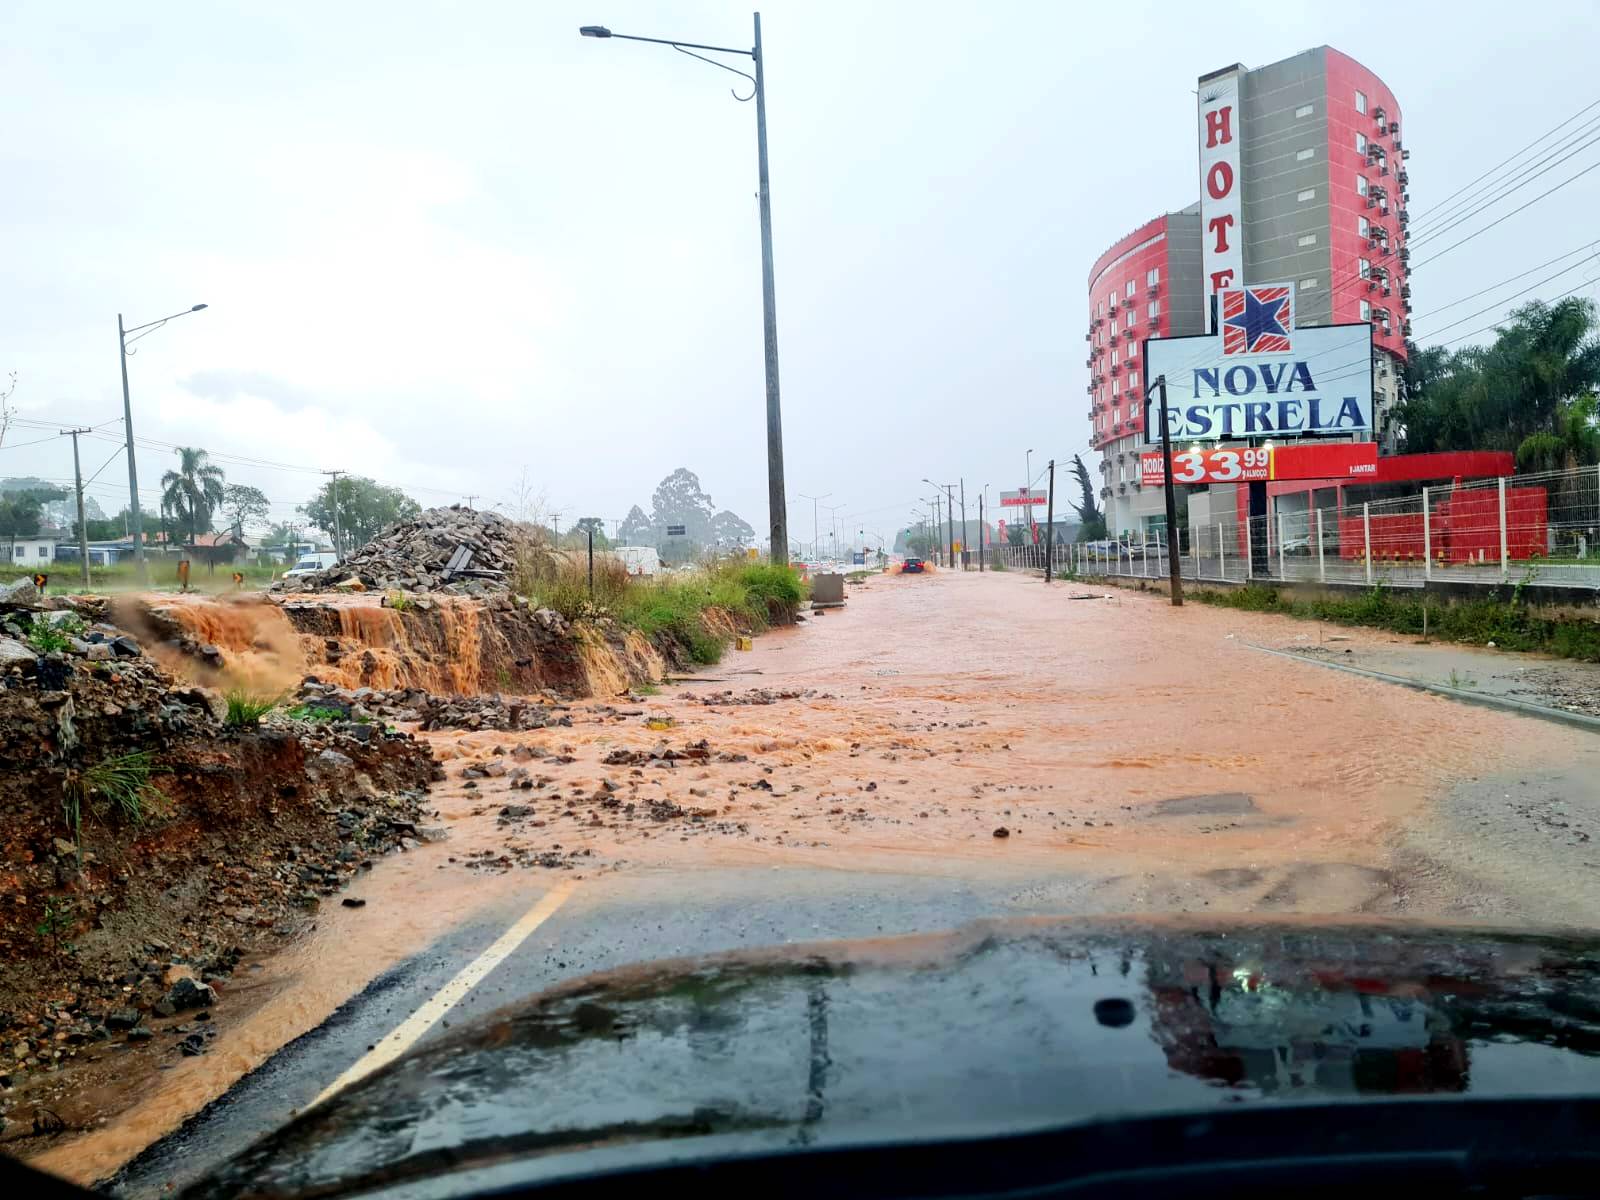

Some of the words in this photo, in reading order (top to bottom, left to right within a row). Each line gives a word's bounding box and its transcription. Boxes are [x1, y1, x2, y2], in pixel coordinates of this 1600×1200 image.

[1205, 106, 1234, 295] HOTE
[1192, 361, 1318, 399] NOVA
[1156, 396, 1368, 438] ESTRELA
